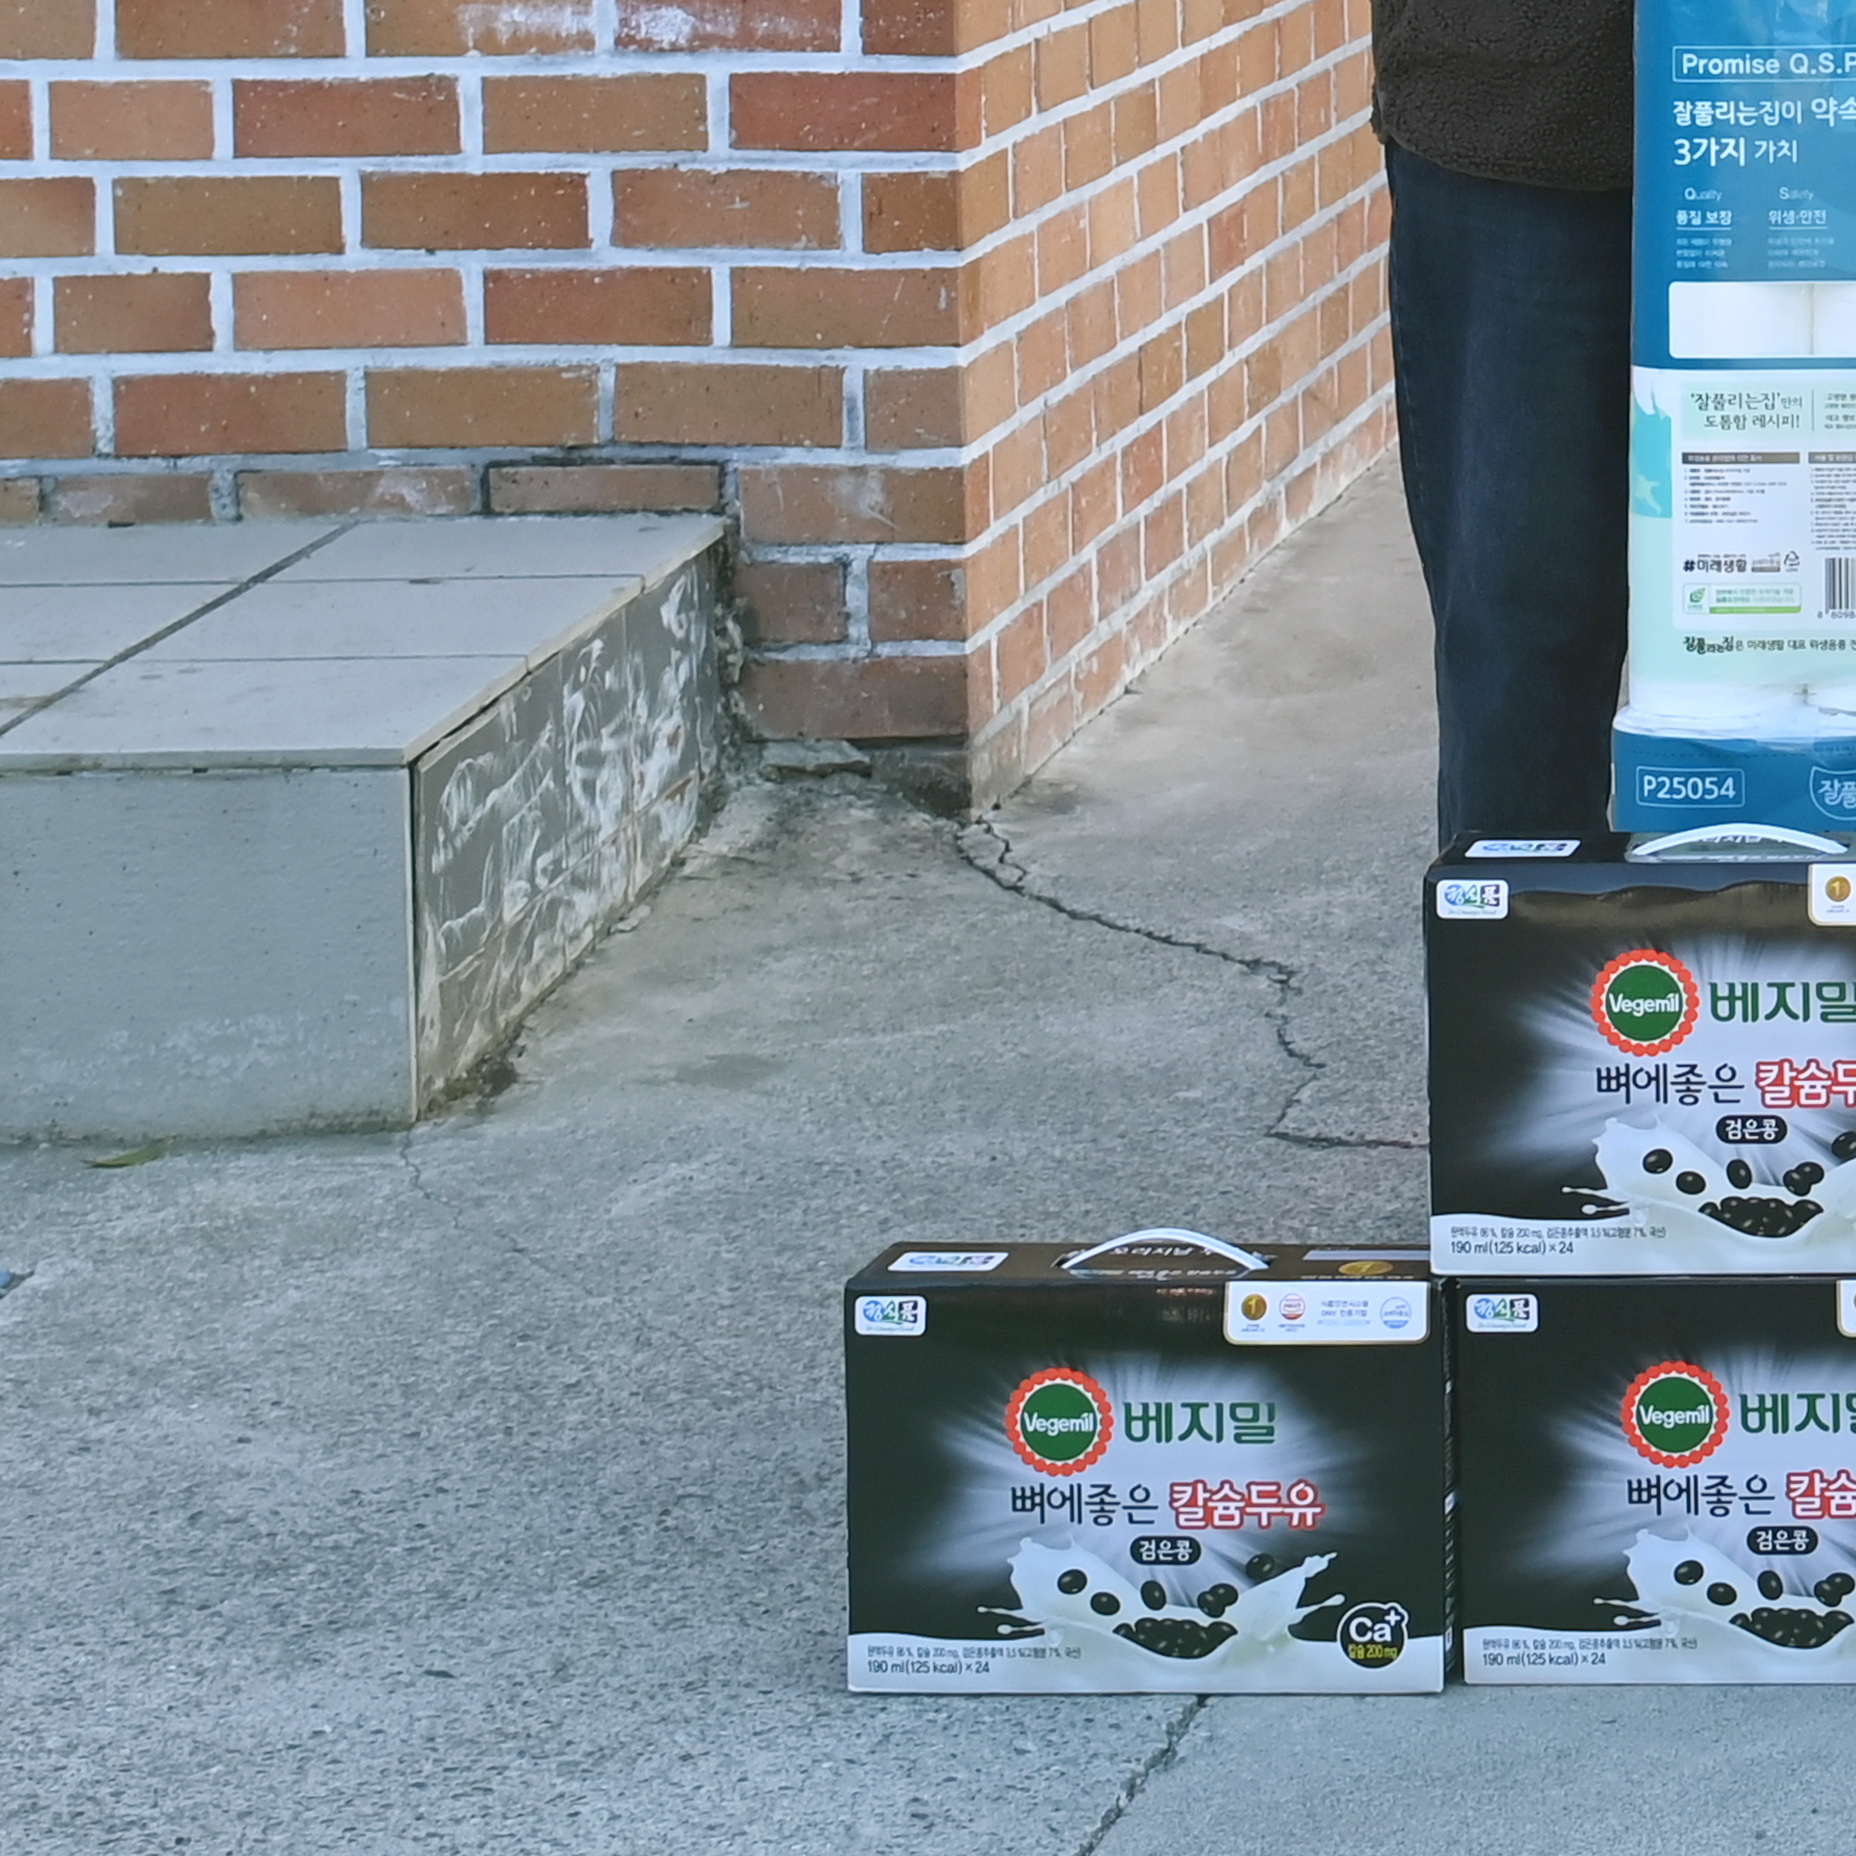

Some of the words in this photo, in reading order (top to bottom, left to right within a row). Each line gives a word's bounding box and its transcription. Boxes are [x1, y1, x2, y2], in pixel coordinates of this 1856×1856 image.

[1682, 53, 1780, 75] Promise
[1673, 100, 1801, 126] 잘풀리는집이
[1673, 137, 1745, 167] 3가지
[1754, 140, 1798, 164] 가치
[1643, 775, 1737, 799] P25054
[1609, 993, 1680, 1017] Vegemil
[1596, 1063, 1745, 1106] 뼈에좋은
[1724, 1118, 1779, 1141] 검은콩
[1451, 1240, 1472, 1254] 190
[1023, 1412, 1094, 1437] Vegemil
[1122, 1401, 1277, 1444] 베지밀
[1640, 1405, 1711, 1429] Vegemil
[1011, 1483, 1159, 1527] 뼈에좋은
[1171, 1480, 1324, 1529] 칼슘두유
[1627, 1474, 1776, 1518] 뼈에좋은
[1138, 1539, 1193, 1562] 검은콩
[1755, 1529, 1810, 1552] 검은콩
[868, 1659, 889, 1673] 190
[1483, 1652, 1504, 1666] 190
